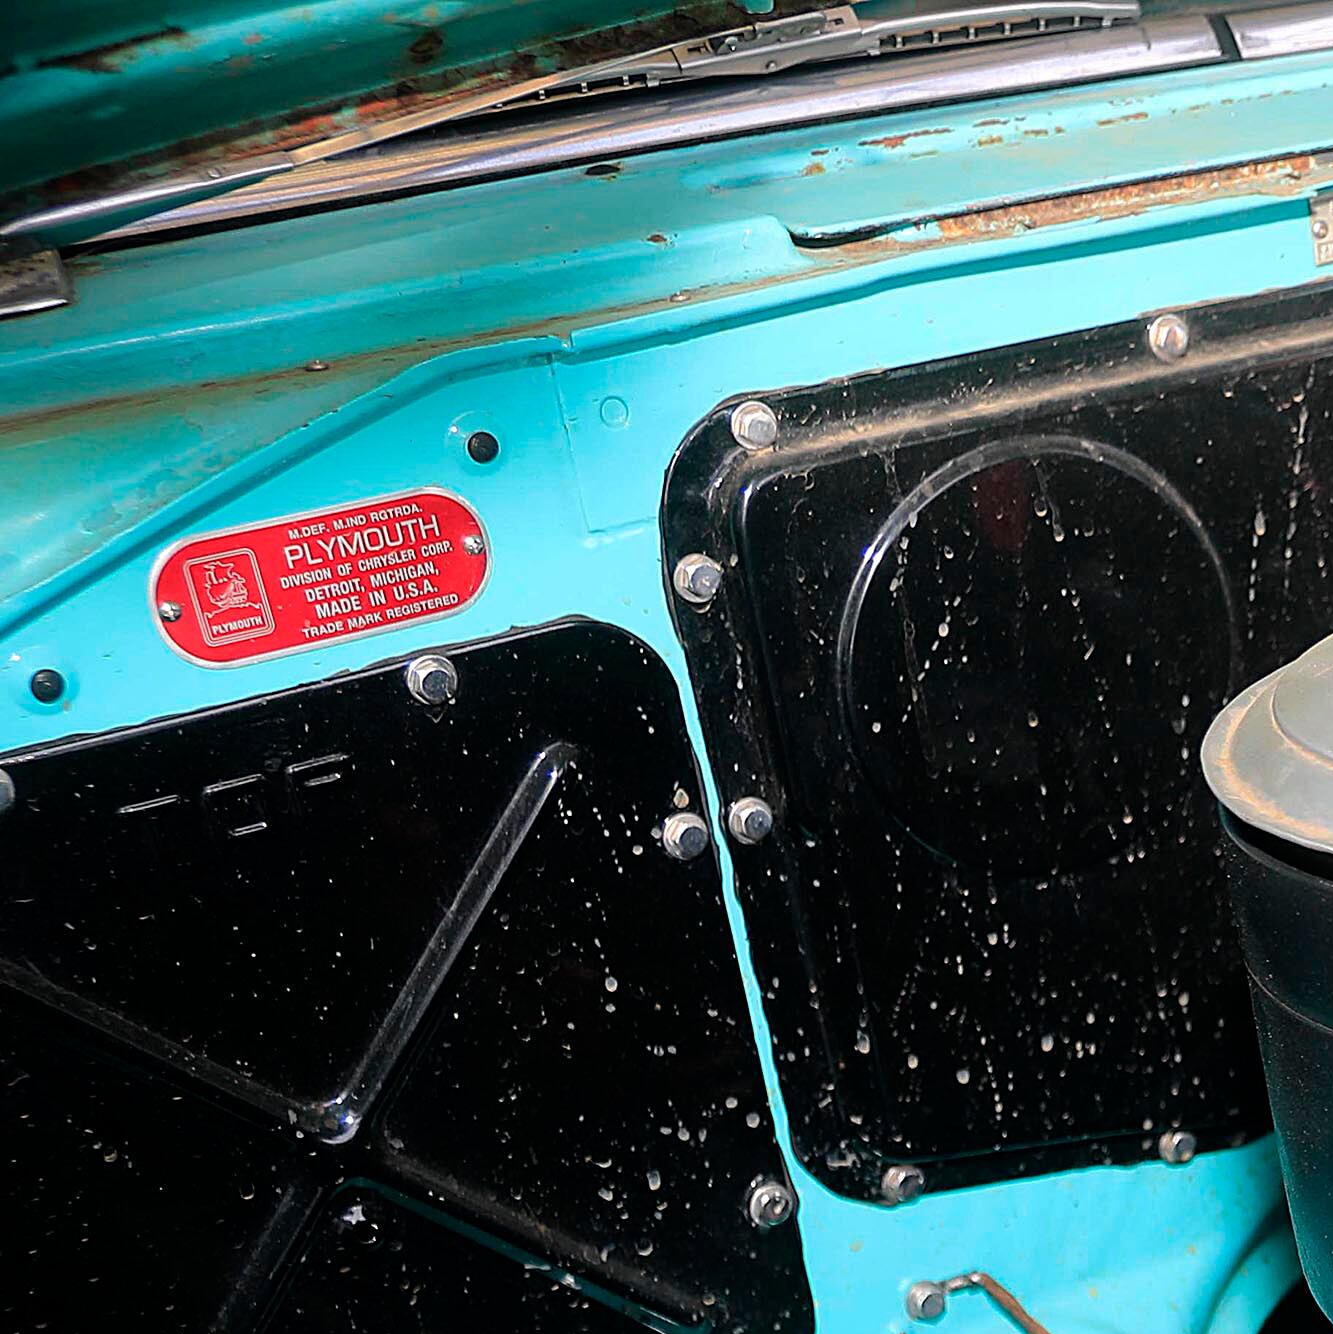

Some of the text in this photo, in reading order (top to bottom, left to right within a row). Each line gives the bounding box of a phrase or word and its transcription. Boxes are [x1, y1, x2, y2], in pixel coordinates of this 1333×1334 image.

[284, 514, 441, 570] PLYMOUTH
[288, 503, 424, 540] M.DEF. M.IND RGTRDA.
[280, 540, 453, 589] DIVISION OF CHRYSLER CORP.
[304, 561, 440, 603] DETROIT, MICHIGAN,
[301, 593, 459, 639] TRADE MARK REGISTERED
[315, 582, 438, 619] MADE IN U.S.A.
[213, 617, 263, 636] PLYMOUTH
